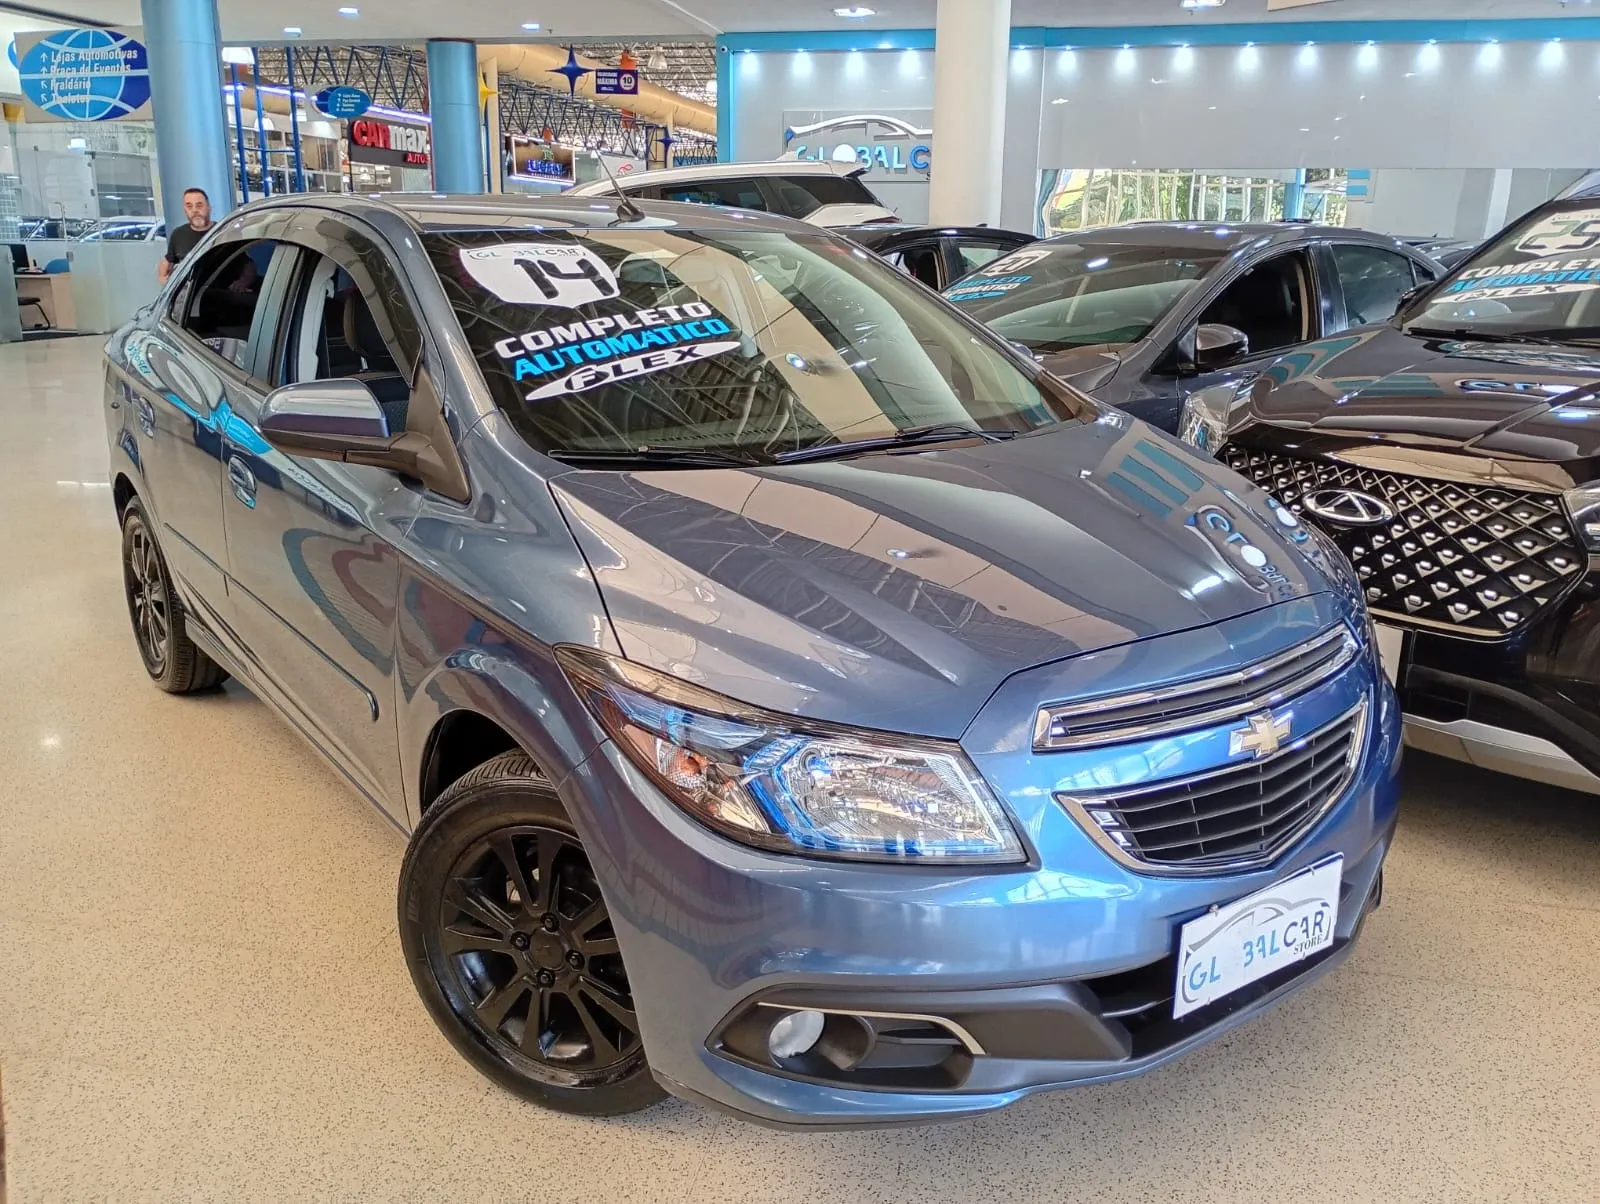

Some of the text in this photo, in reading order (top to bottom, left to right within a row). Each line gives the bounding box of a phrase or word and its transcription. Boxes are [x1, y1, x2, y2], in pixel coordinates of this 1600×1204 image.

[51, 49, 138, 64] Lojas Automotivas
[94, 63, 131, 74] Eventos
[513, 257, 615, 300] 14
[494, 301, 712, 359] COMPLETO
[515, 318, 731, 381] AUTOMATICO
[564, 344, 704, 392] FLEX
[1293, 934, 1323, 955] STORE
